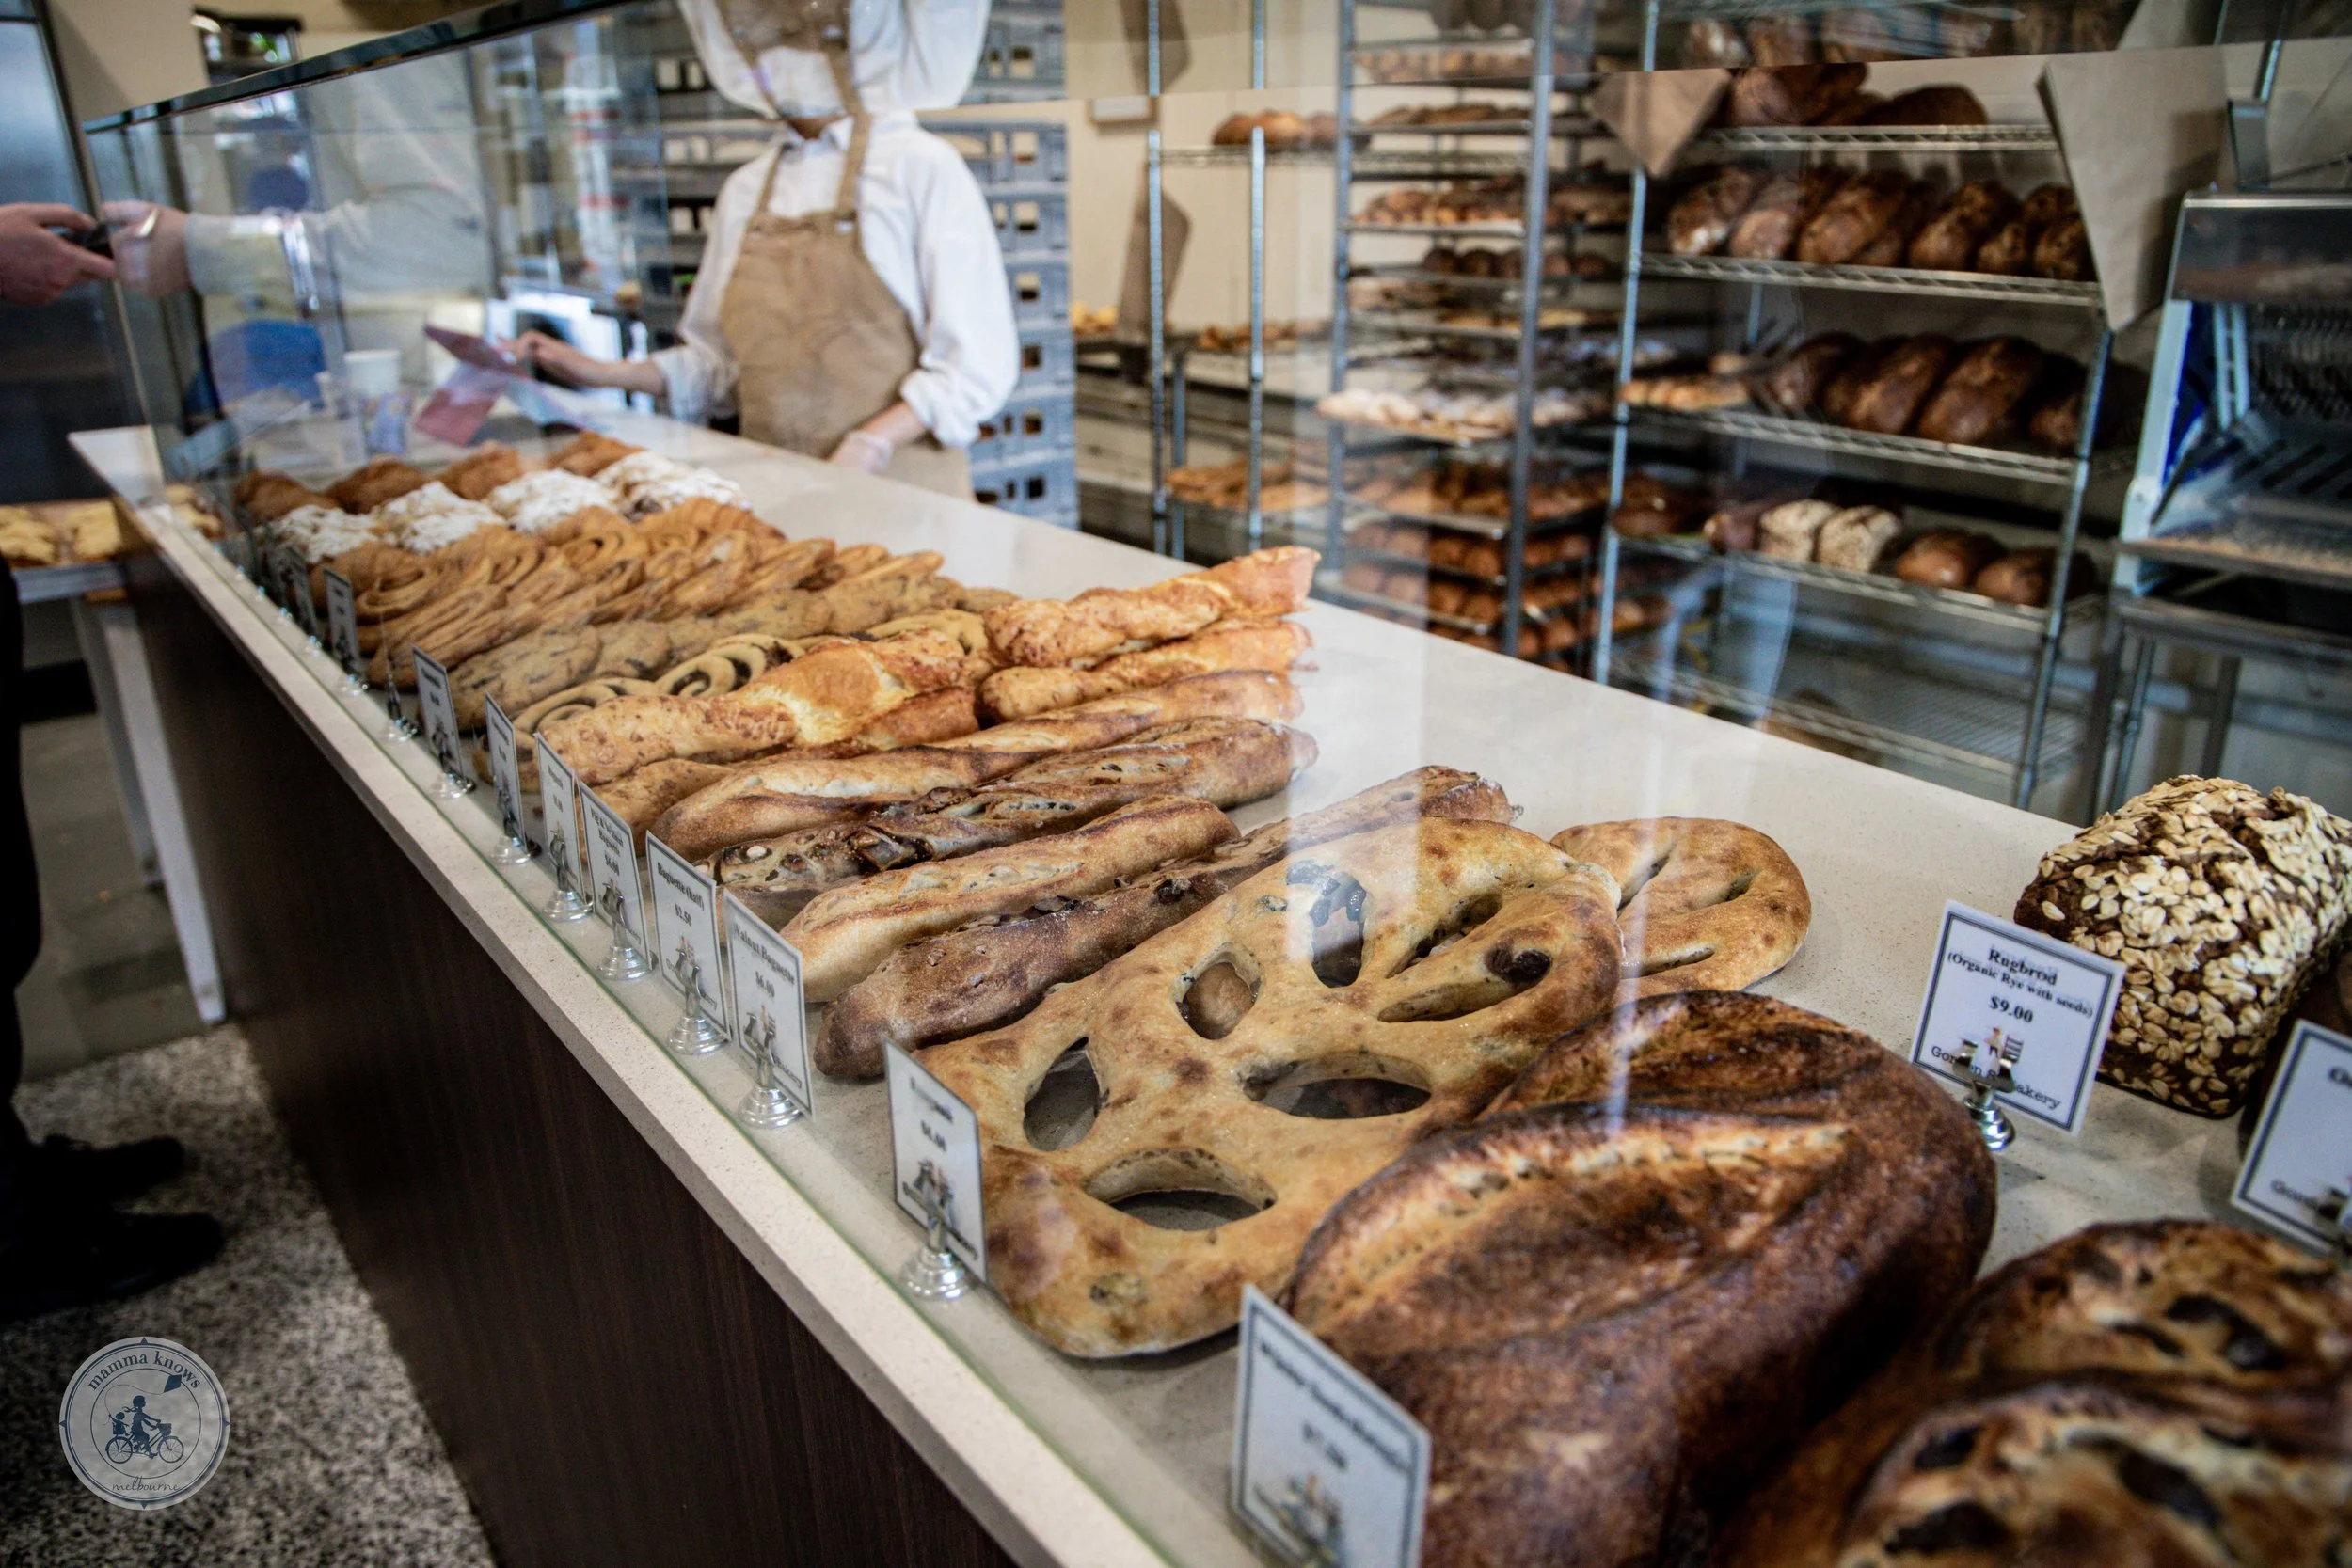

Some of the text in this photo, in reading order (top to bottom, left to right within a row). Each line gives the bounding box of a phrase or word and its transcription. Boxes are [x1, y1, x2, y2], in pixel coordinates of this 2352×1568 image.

[657, 861, 705, 911] Baguette (half)
[675, 903, 692, 927] $2.50
[760, 944, 795, 985] Baguette
[1947, 951, 2094, 1020] (Organic Rye with seeds)
[1989, 994, 2035, 1023] $9.00
[1931, 1045, 1982, 1077] Gorn
[2014, 1084, 2061, 1111] akery
